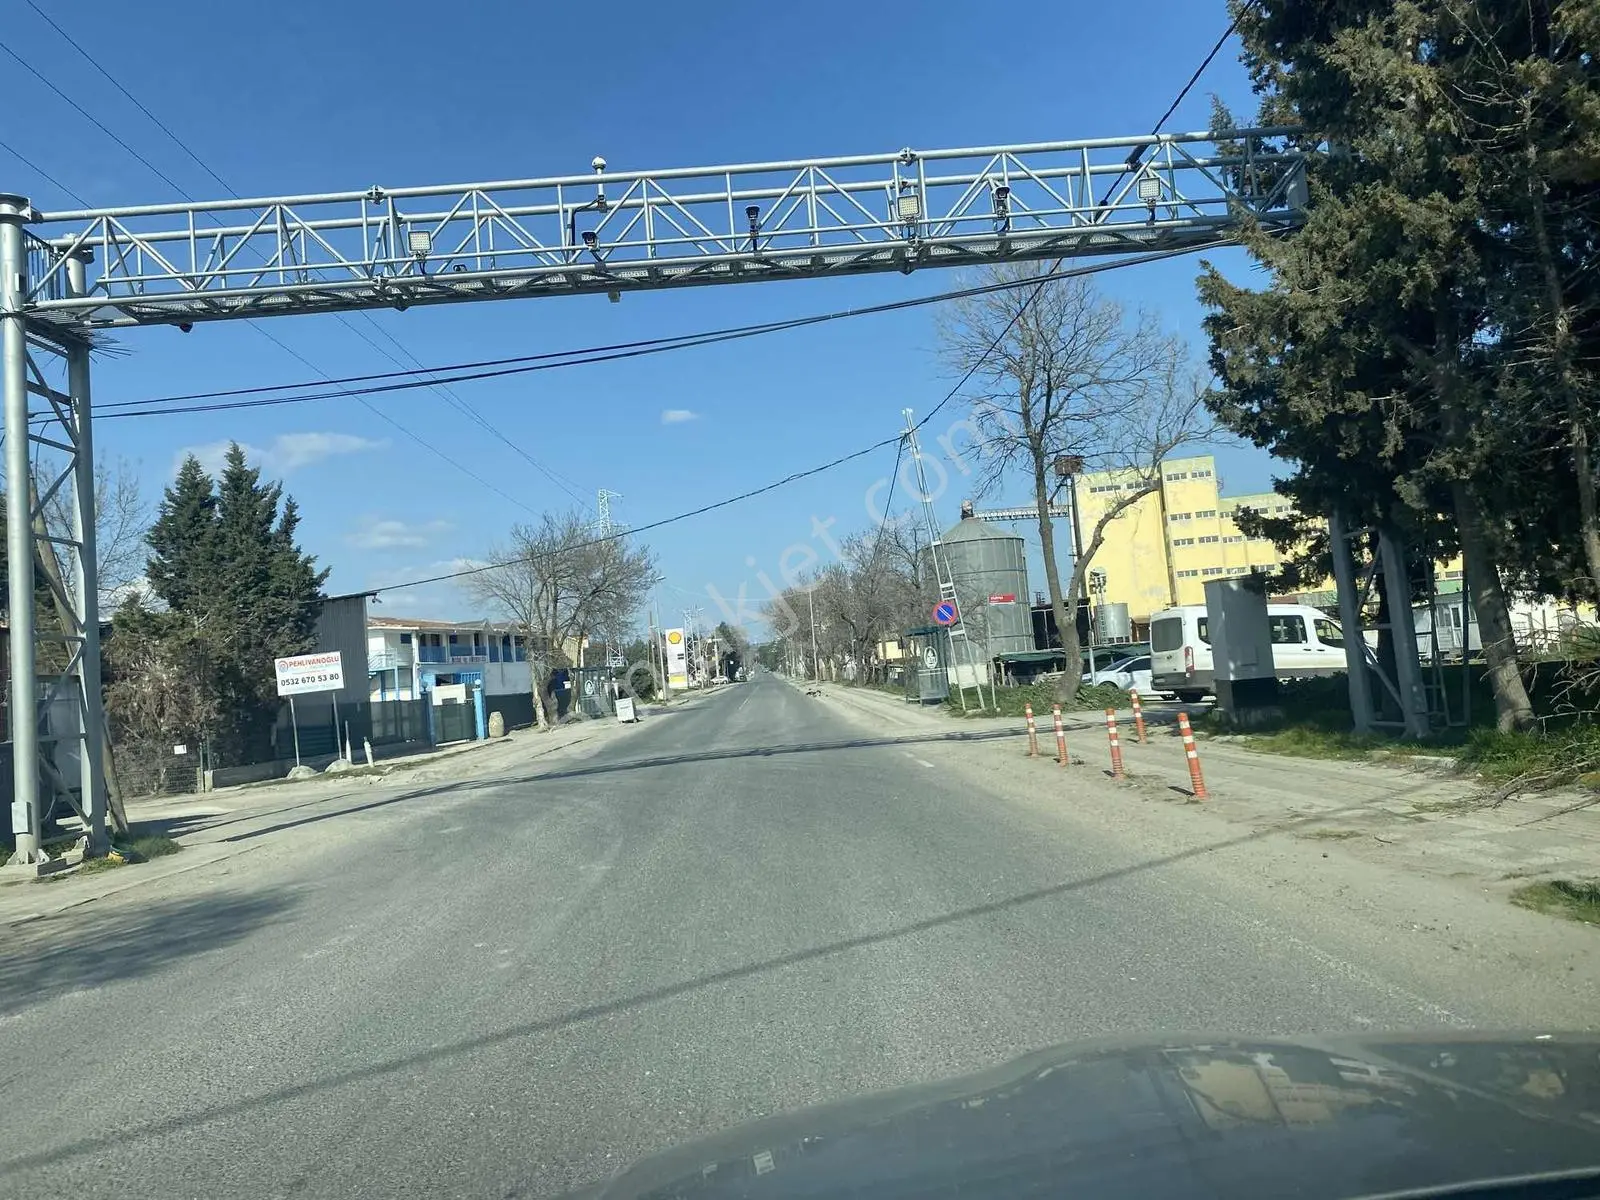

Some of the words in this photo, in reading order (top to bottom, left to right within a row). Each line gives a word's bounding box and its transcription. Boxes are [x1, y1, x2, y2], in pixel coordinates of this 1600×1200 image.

[281, 678, 299, 687] 0532
[301, 676, 315, 684] 670
[318, 674, 327, 682] 53
[329, 673, 339, 681] 80
